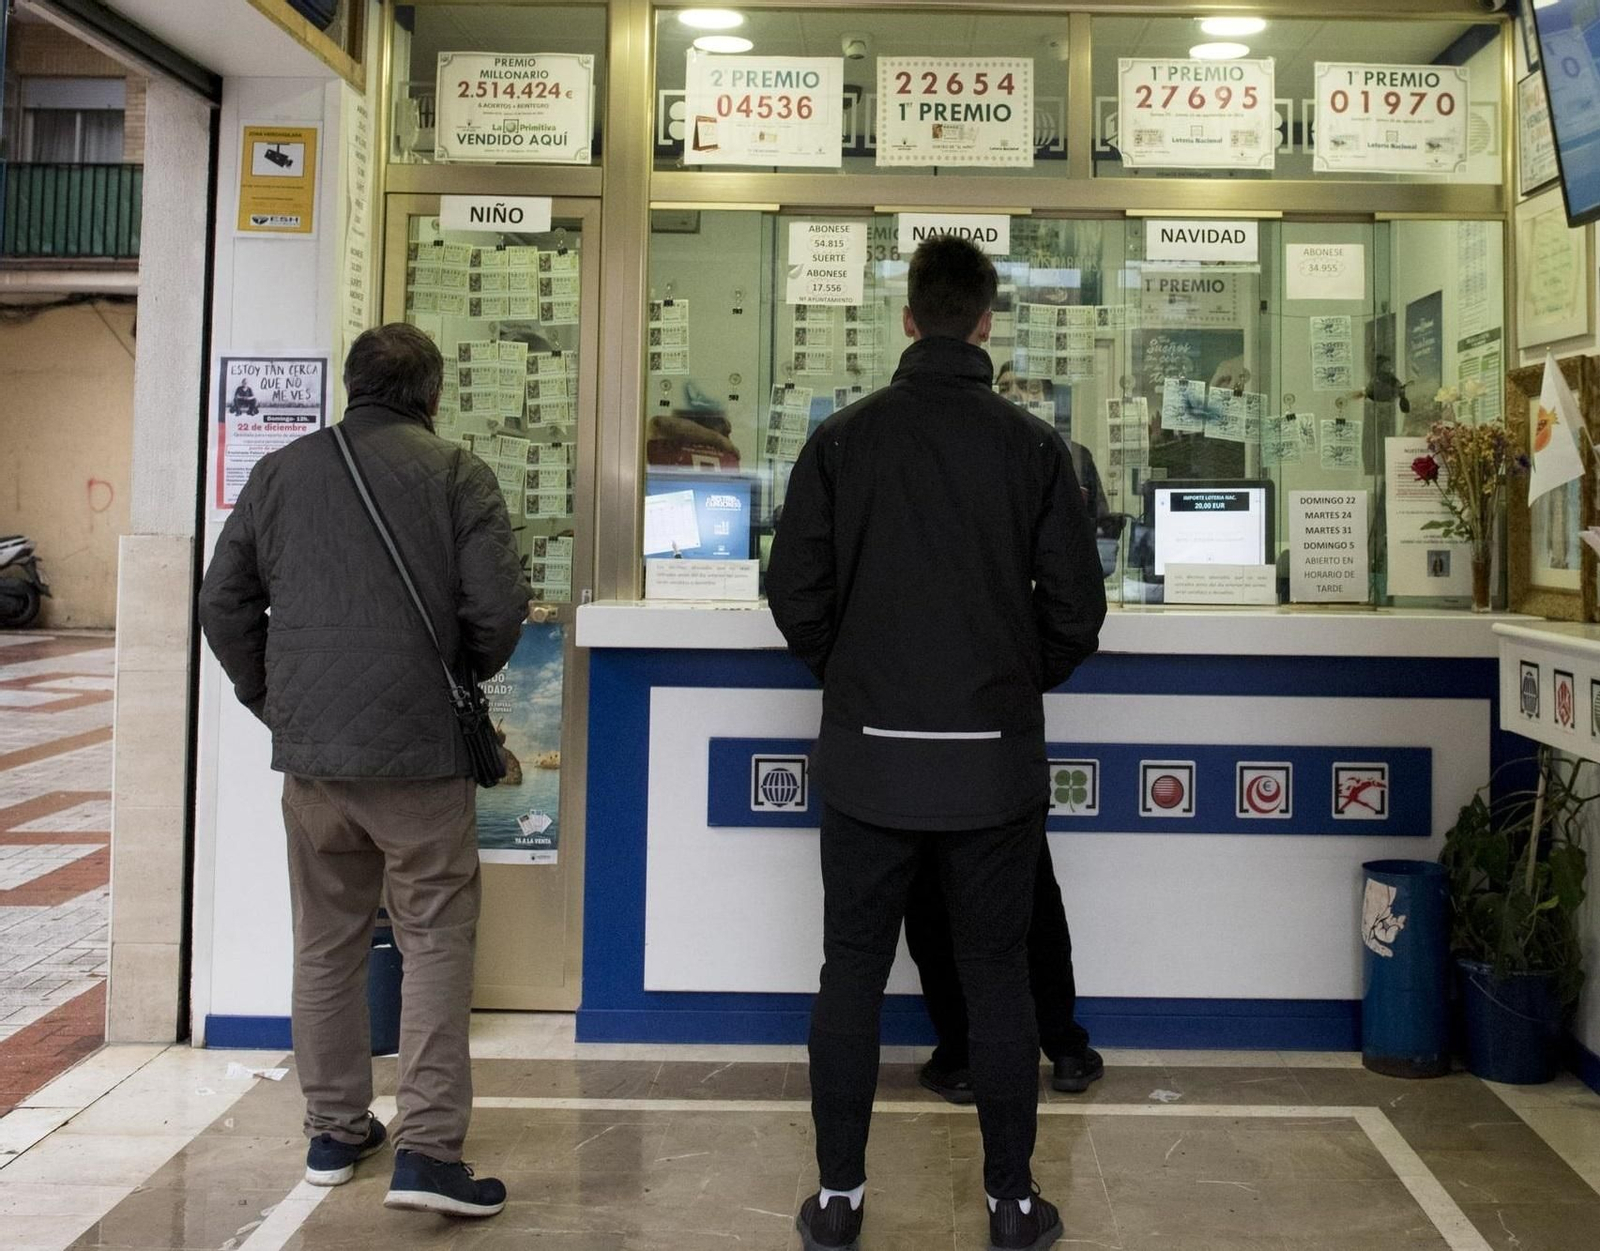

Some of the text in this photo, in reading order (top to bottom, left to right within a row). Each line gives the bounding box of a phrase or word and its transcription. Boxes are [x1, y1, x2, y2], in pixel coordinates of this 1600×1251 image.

[494, 58, 536, 68] PREMIO
[480, 70, 549, 80] MILLONARIO
[732, 70, 820, 88] PREMIO
[1168, 66, 1244, 82] PREMIO
[1364, 72, 1440, 88] PREMIO
[458, 80, 573, 100] 2.514.424 €
[895, 71, 1015, 96] 22654
[1135, 84, 1258, 110] 27695
[1330, 90, 1456, 116] 01970
[716, 94, 813, 120] 04536
[919, 102, 1012, 122] PREMIO
[492, 122, 556, 131] La Primitiva
[456, 132, 568, 146] VENDIDO AQUÍ
[470, 203, 524, 224] NIÑO
[808, 224, 850, 233] ABONESE
[1161, 228, 1246, 244] NAVIDAD
[814, 239, 844, 248] 54.815
[812, 254, 846, 262] SUERTE
[1303, 248, 1344, 257] ABONESE
[806, 269, 848, 278] ABONESE
[1308, 263, 1338, 272] 34.955
[812, 284, 842, 292] 17.556
[1160, 279, 1225, 293] PREMIO
[231, 364, 318, 376] ESTOY TAN CERCA
[260, 378, 302, 390] QUE NO
[272, 389, 311, 401] ME VES
